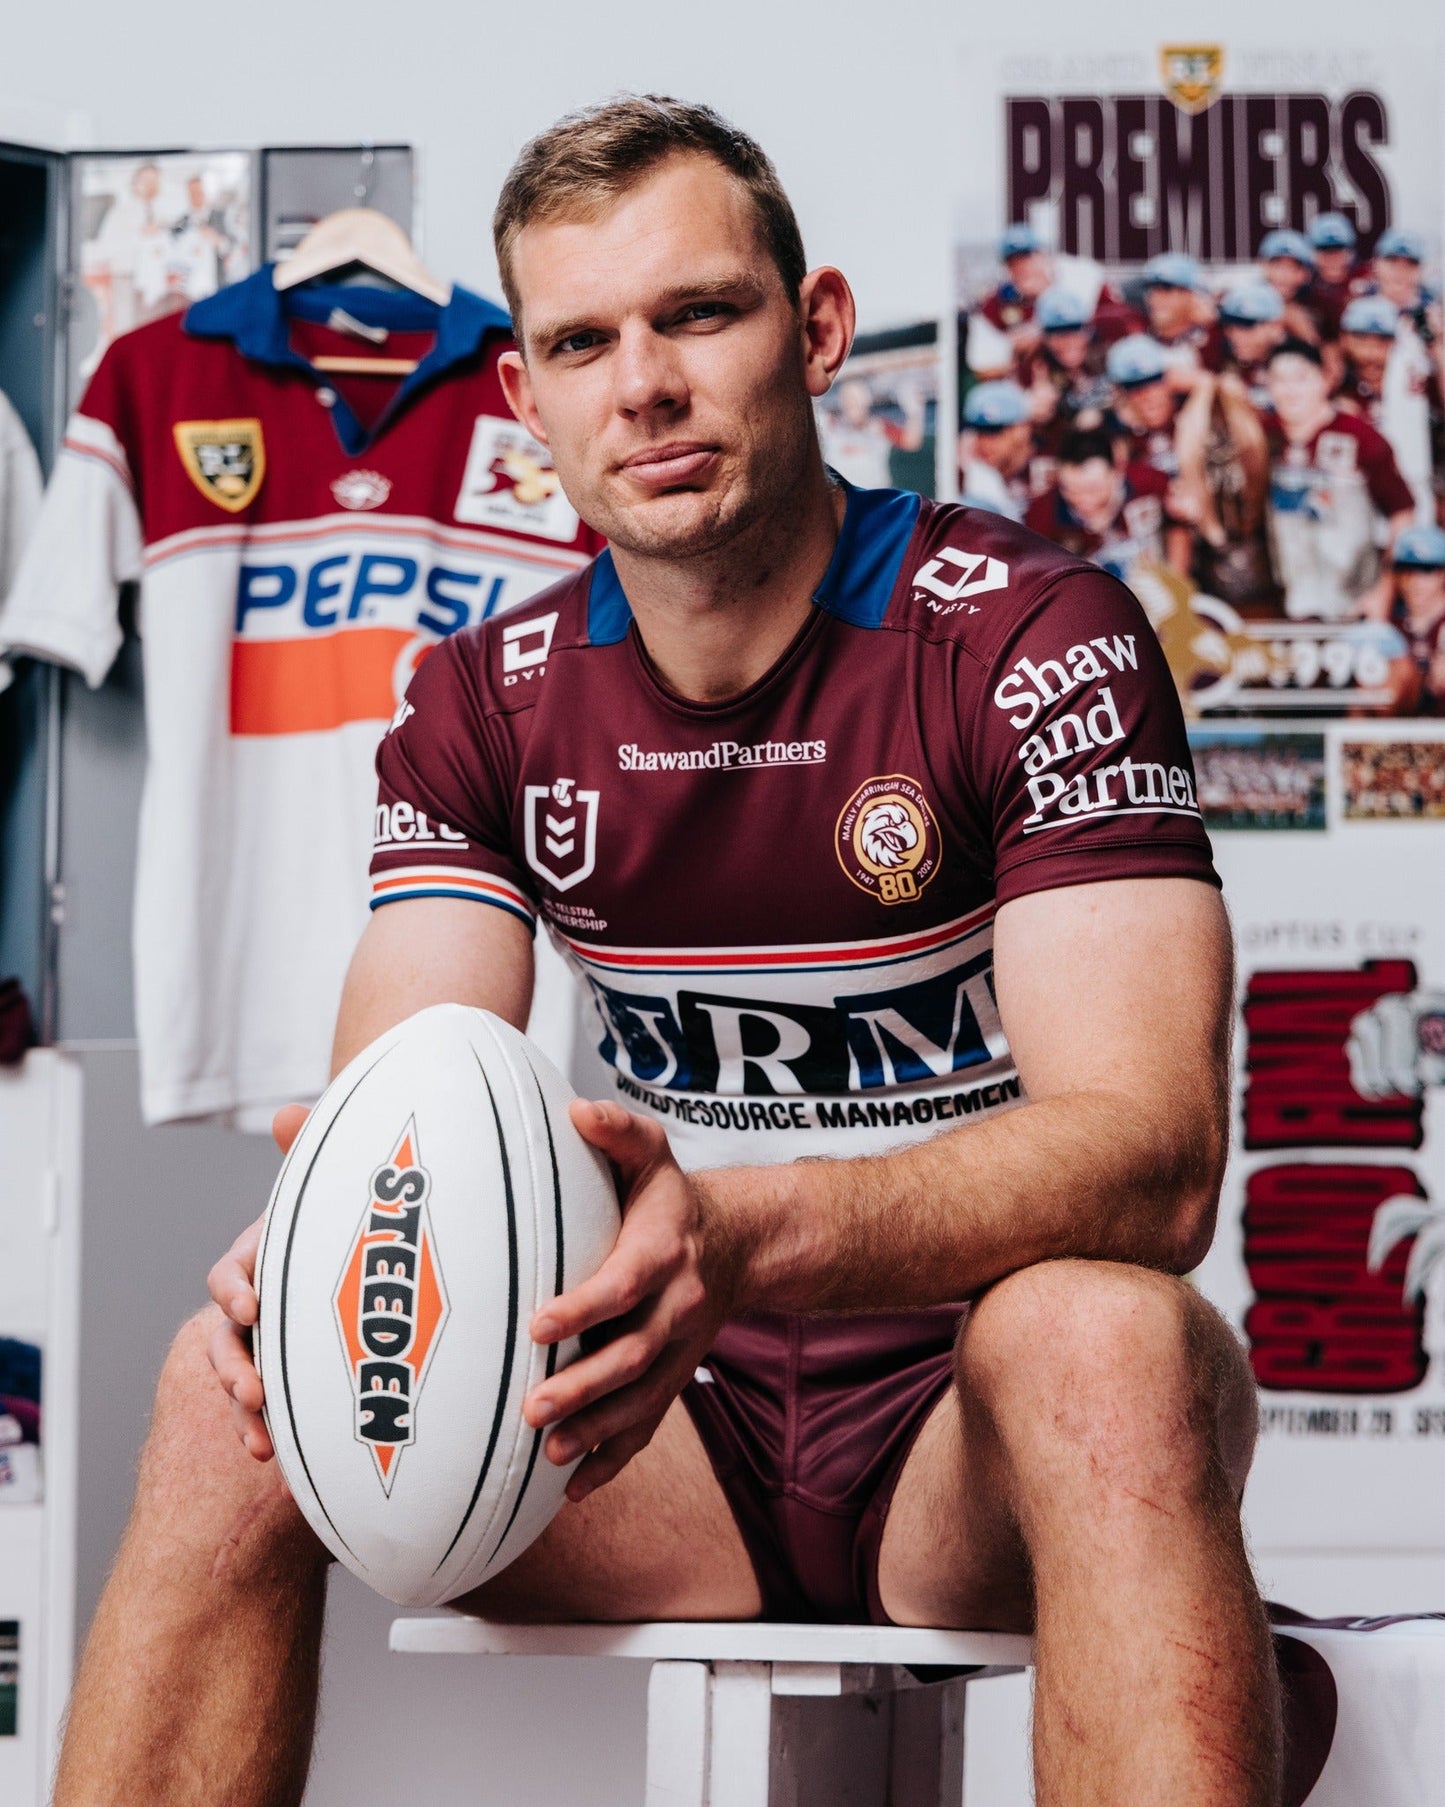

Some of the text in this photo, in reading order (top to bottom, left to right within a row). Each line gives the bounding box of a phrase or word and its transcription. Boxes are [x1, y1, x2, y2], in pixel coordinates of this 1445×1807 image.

[1004, 91, 1393, 263] PREMIERS
[236, 554, 505, 636] PEPSI
[994, 634, 1139, 731] Shaw
[617, 739, 827, 771] ShawandPartners
[1018, 686, 1127, 777] and
[842, 806, 858, 841] MANLY
[855, 781, 900, 808] WARRINGAH
[901, 783, 916, 798] SEA
[855, 869, 876, 887] 1947
[878, 870, 918, 902] 80
[916, 858, 934, 879] 2026
[555, 902, 596, 918] TELSTRA
[594, 965, 1011, 1096] URM
[357, 1166, 427, 1443] STEEDEN
